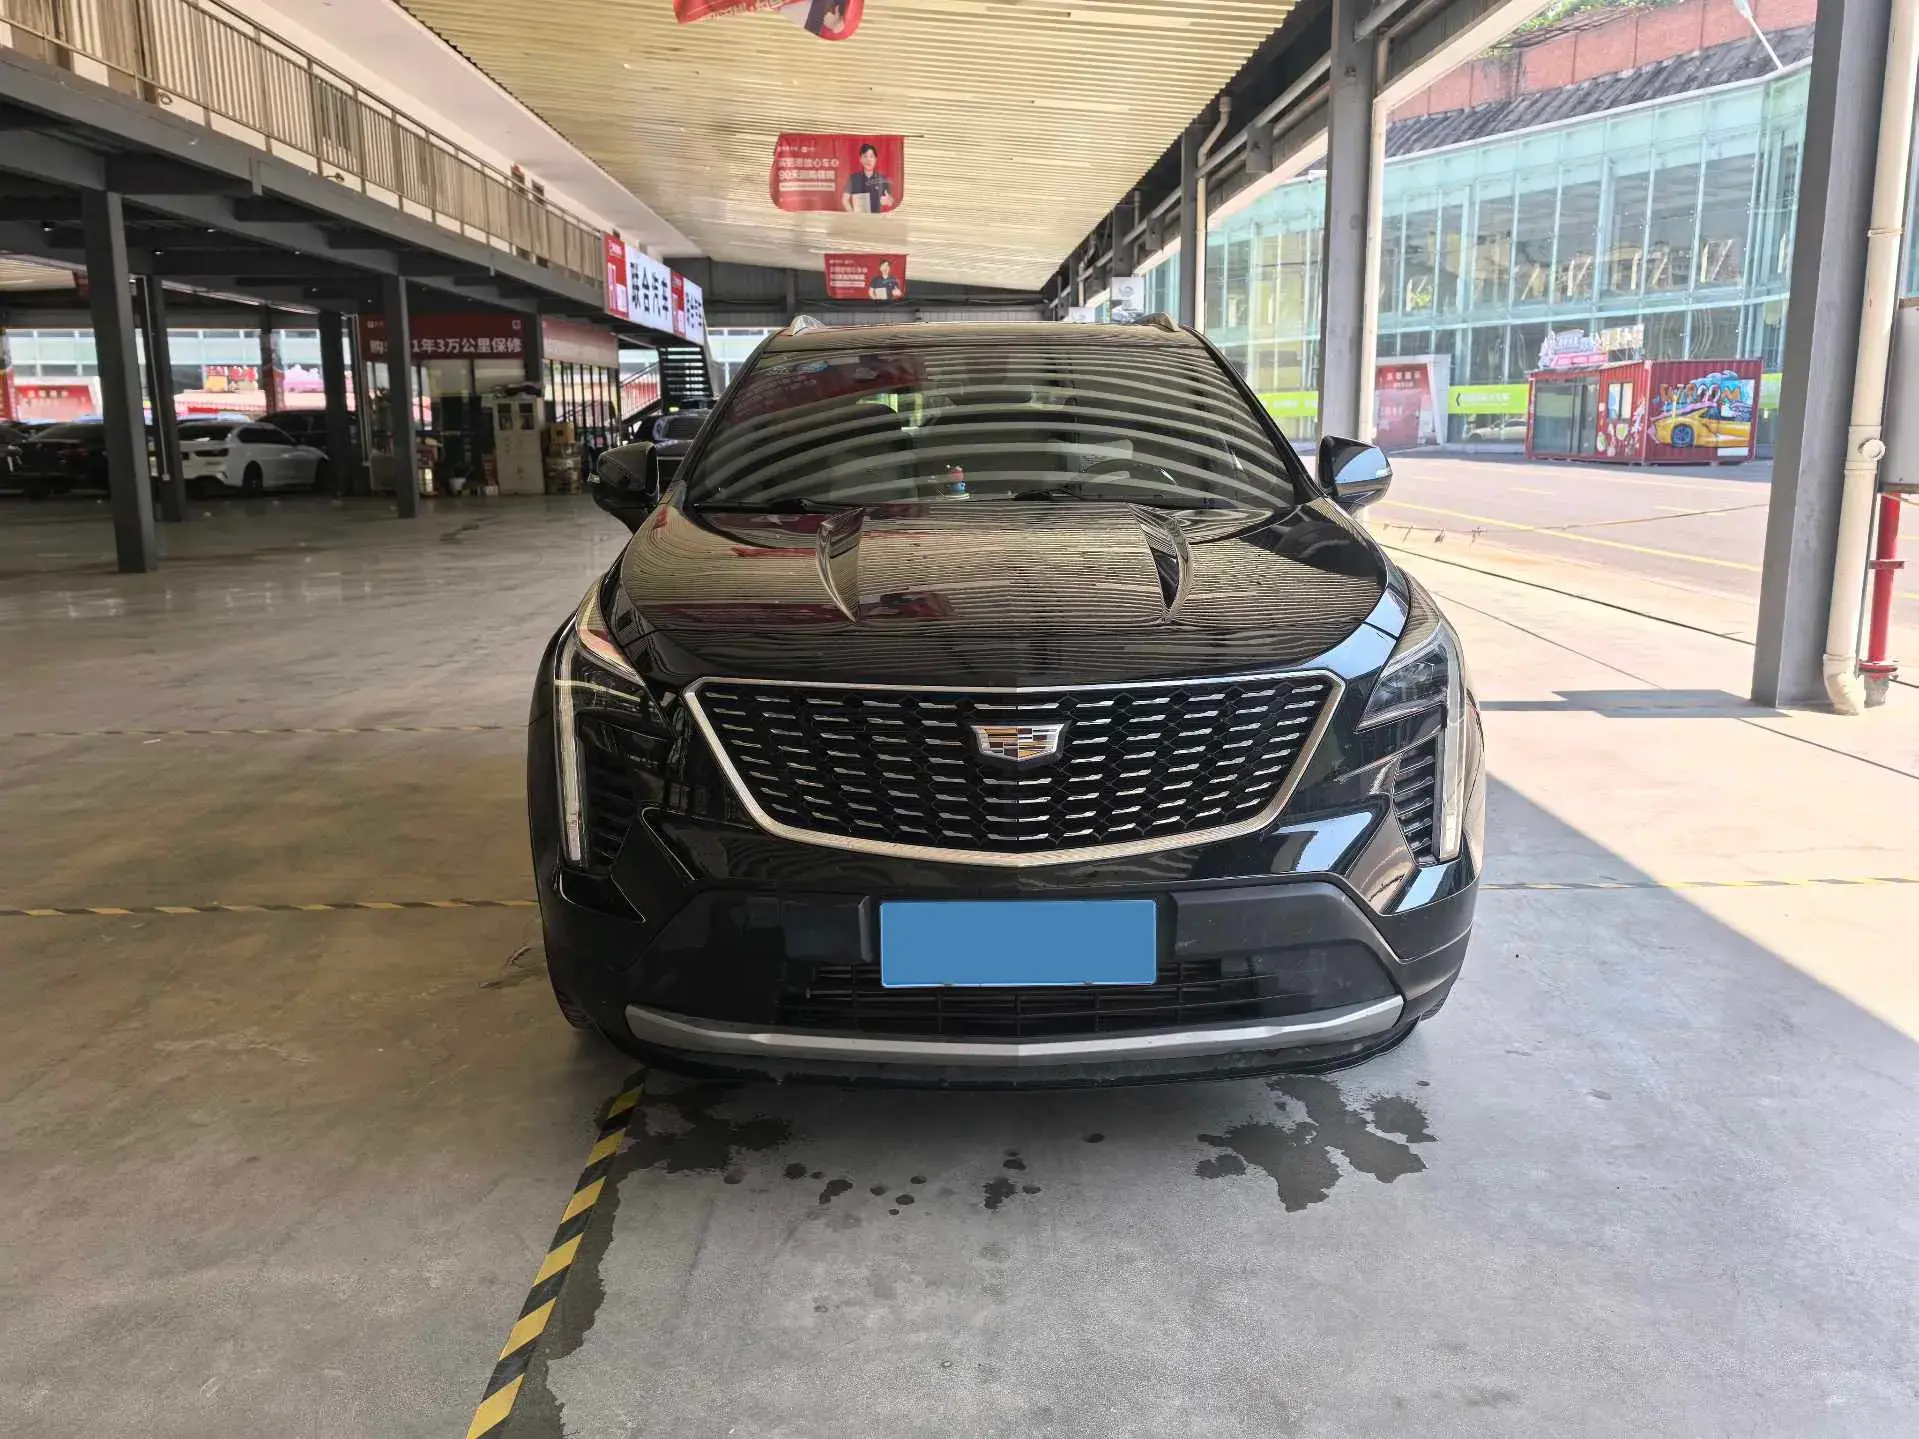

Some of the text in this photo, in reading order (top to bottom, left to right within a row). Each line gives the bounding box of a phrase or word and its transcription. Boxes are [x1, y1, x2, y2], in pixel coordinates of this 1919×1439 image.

[630, 262, 669, 320] 联合汽车
[369, 337, 522, 354] 购 1年3万公里保修
